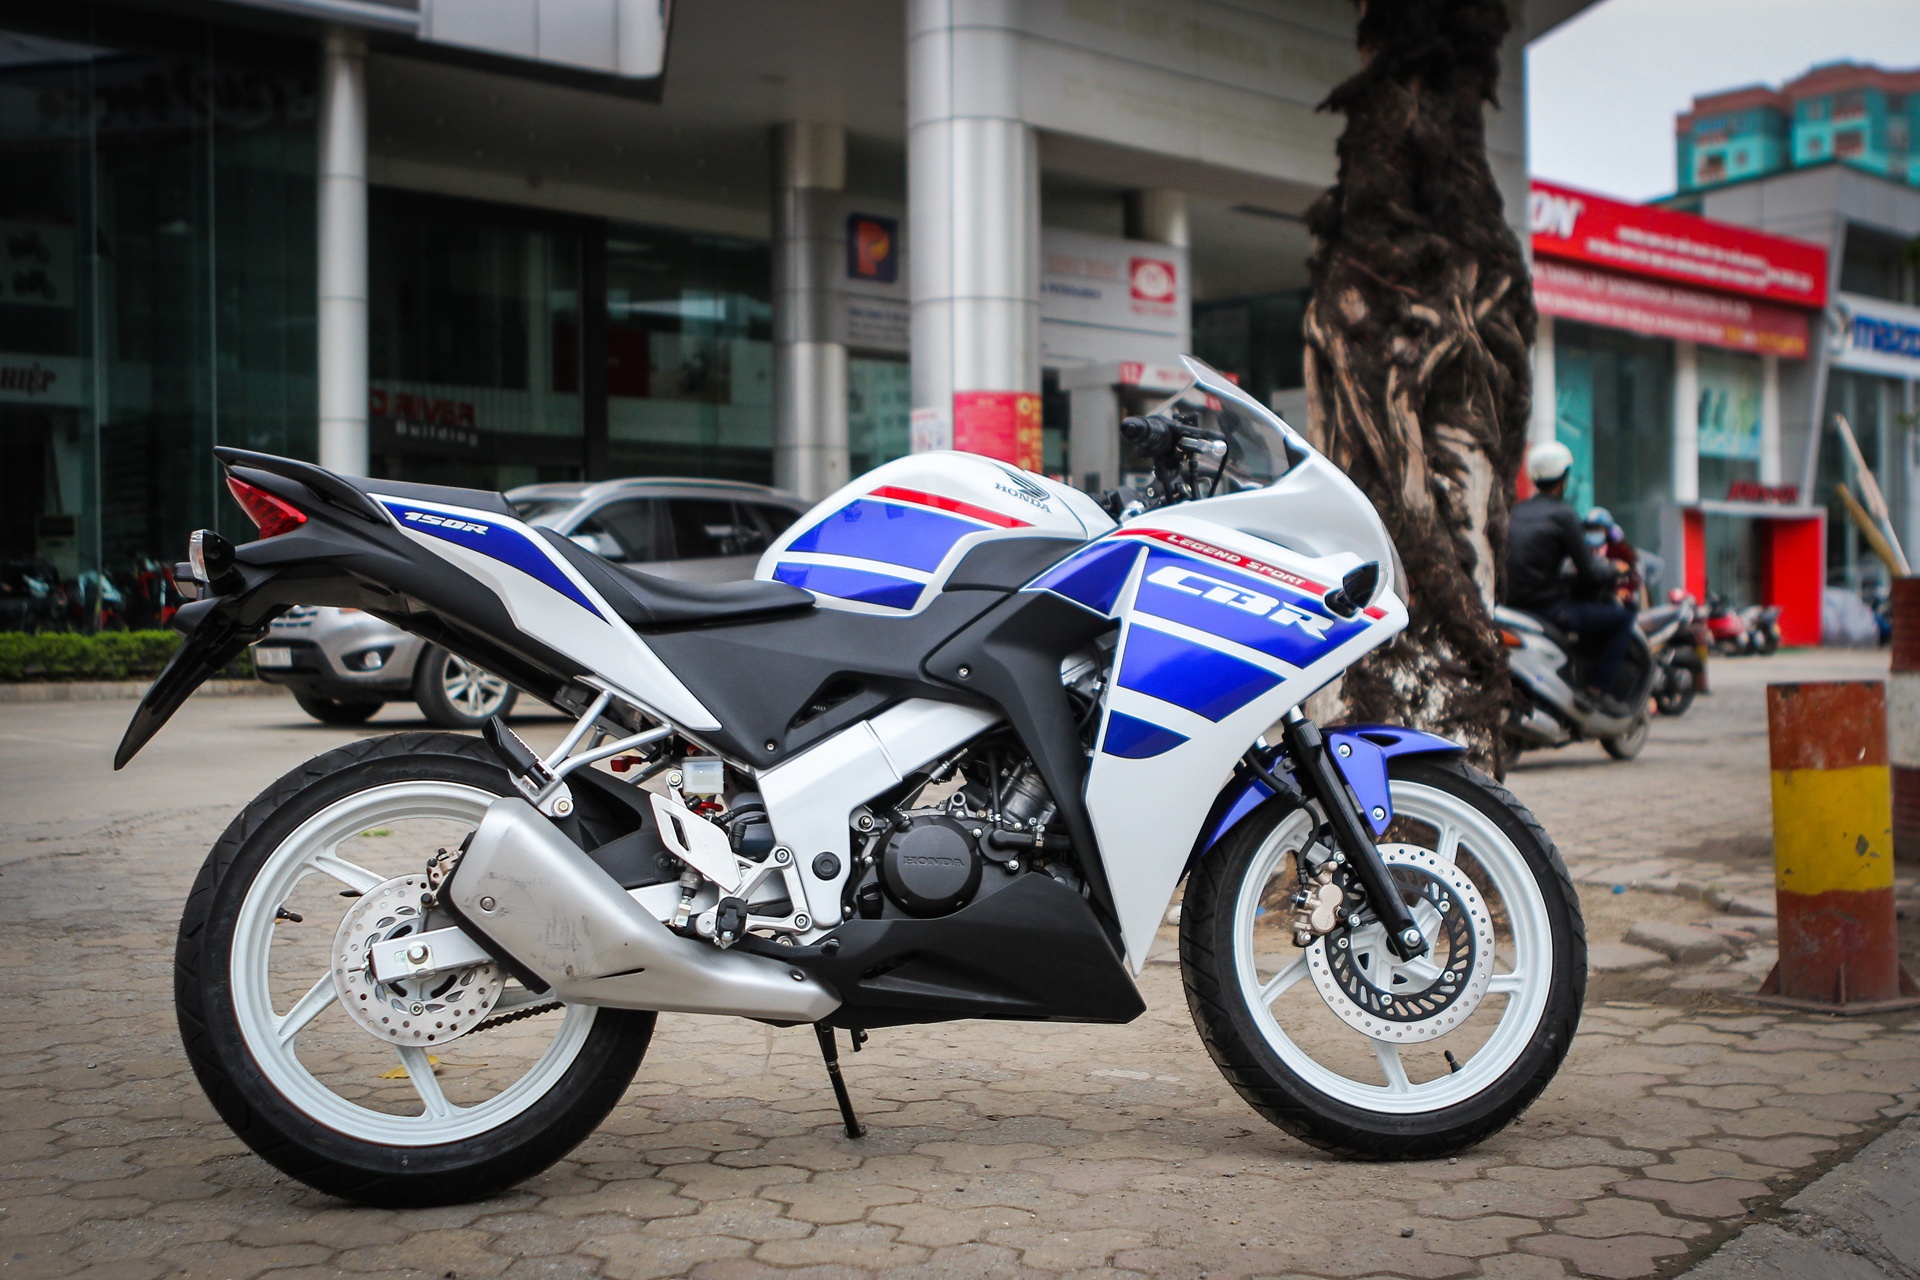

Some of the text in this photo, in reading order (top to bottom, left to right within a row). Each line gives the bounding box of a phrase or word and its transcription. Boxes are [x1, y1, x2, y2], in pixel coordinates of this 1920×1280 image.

[995, 481, 1053, 514] HONDA
[404, 511, 489, 535] 150R
[1167, 534, 1307, 586] LEGEND SPORT
[1147, 565, 1335, 641] CBR
[903, 855, 967, 868] HONDA
